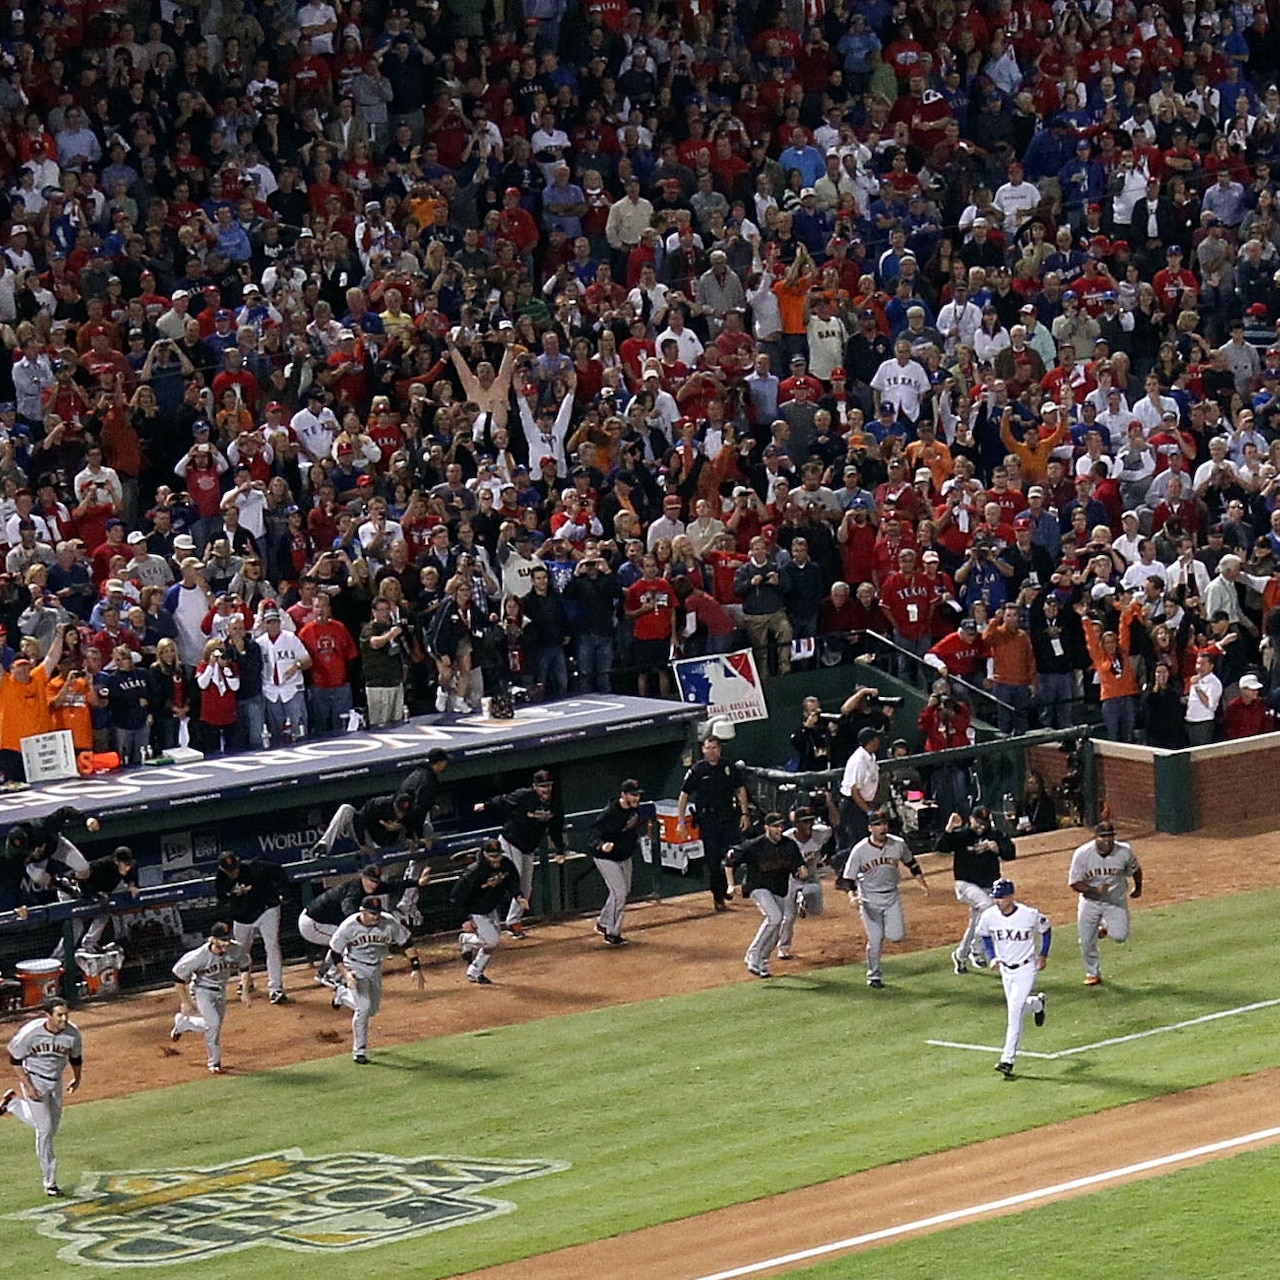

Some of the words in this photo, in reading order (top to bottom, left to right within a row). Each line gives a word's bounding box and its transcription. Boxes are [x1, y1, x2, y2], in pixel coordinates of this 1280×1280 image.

[886, 377, 921, 389] TEXAS
[897, 587, 928, 600] TEXAS
[119, 679, 147, 690] TEXAS
[128, 722, 499, 788] WORLD
